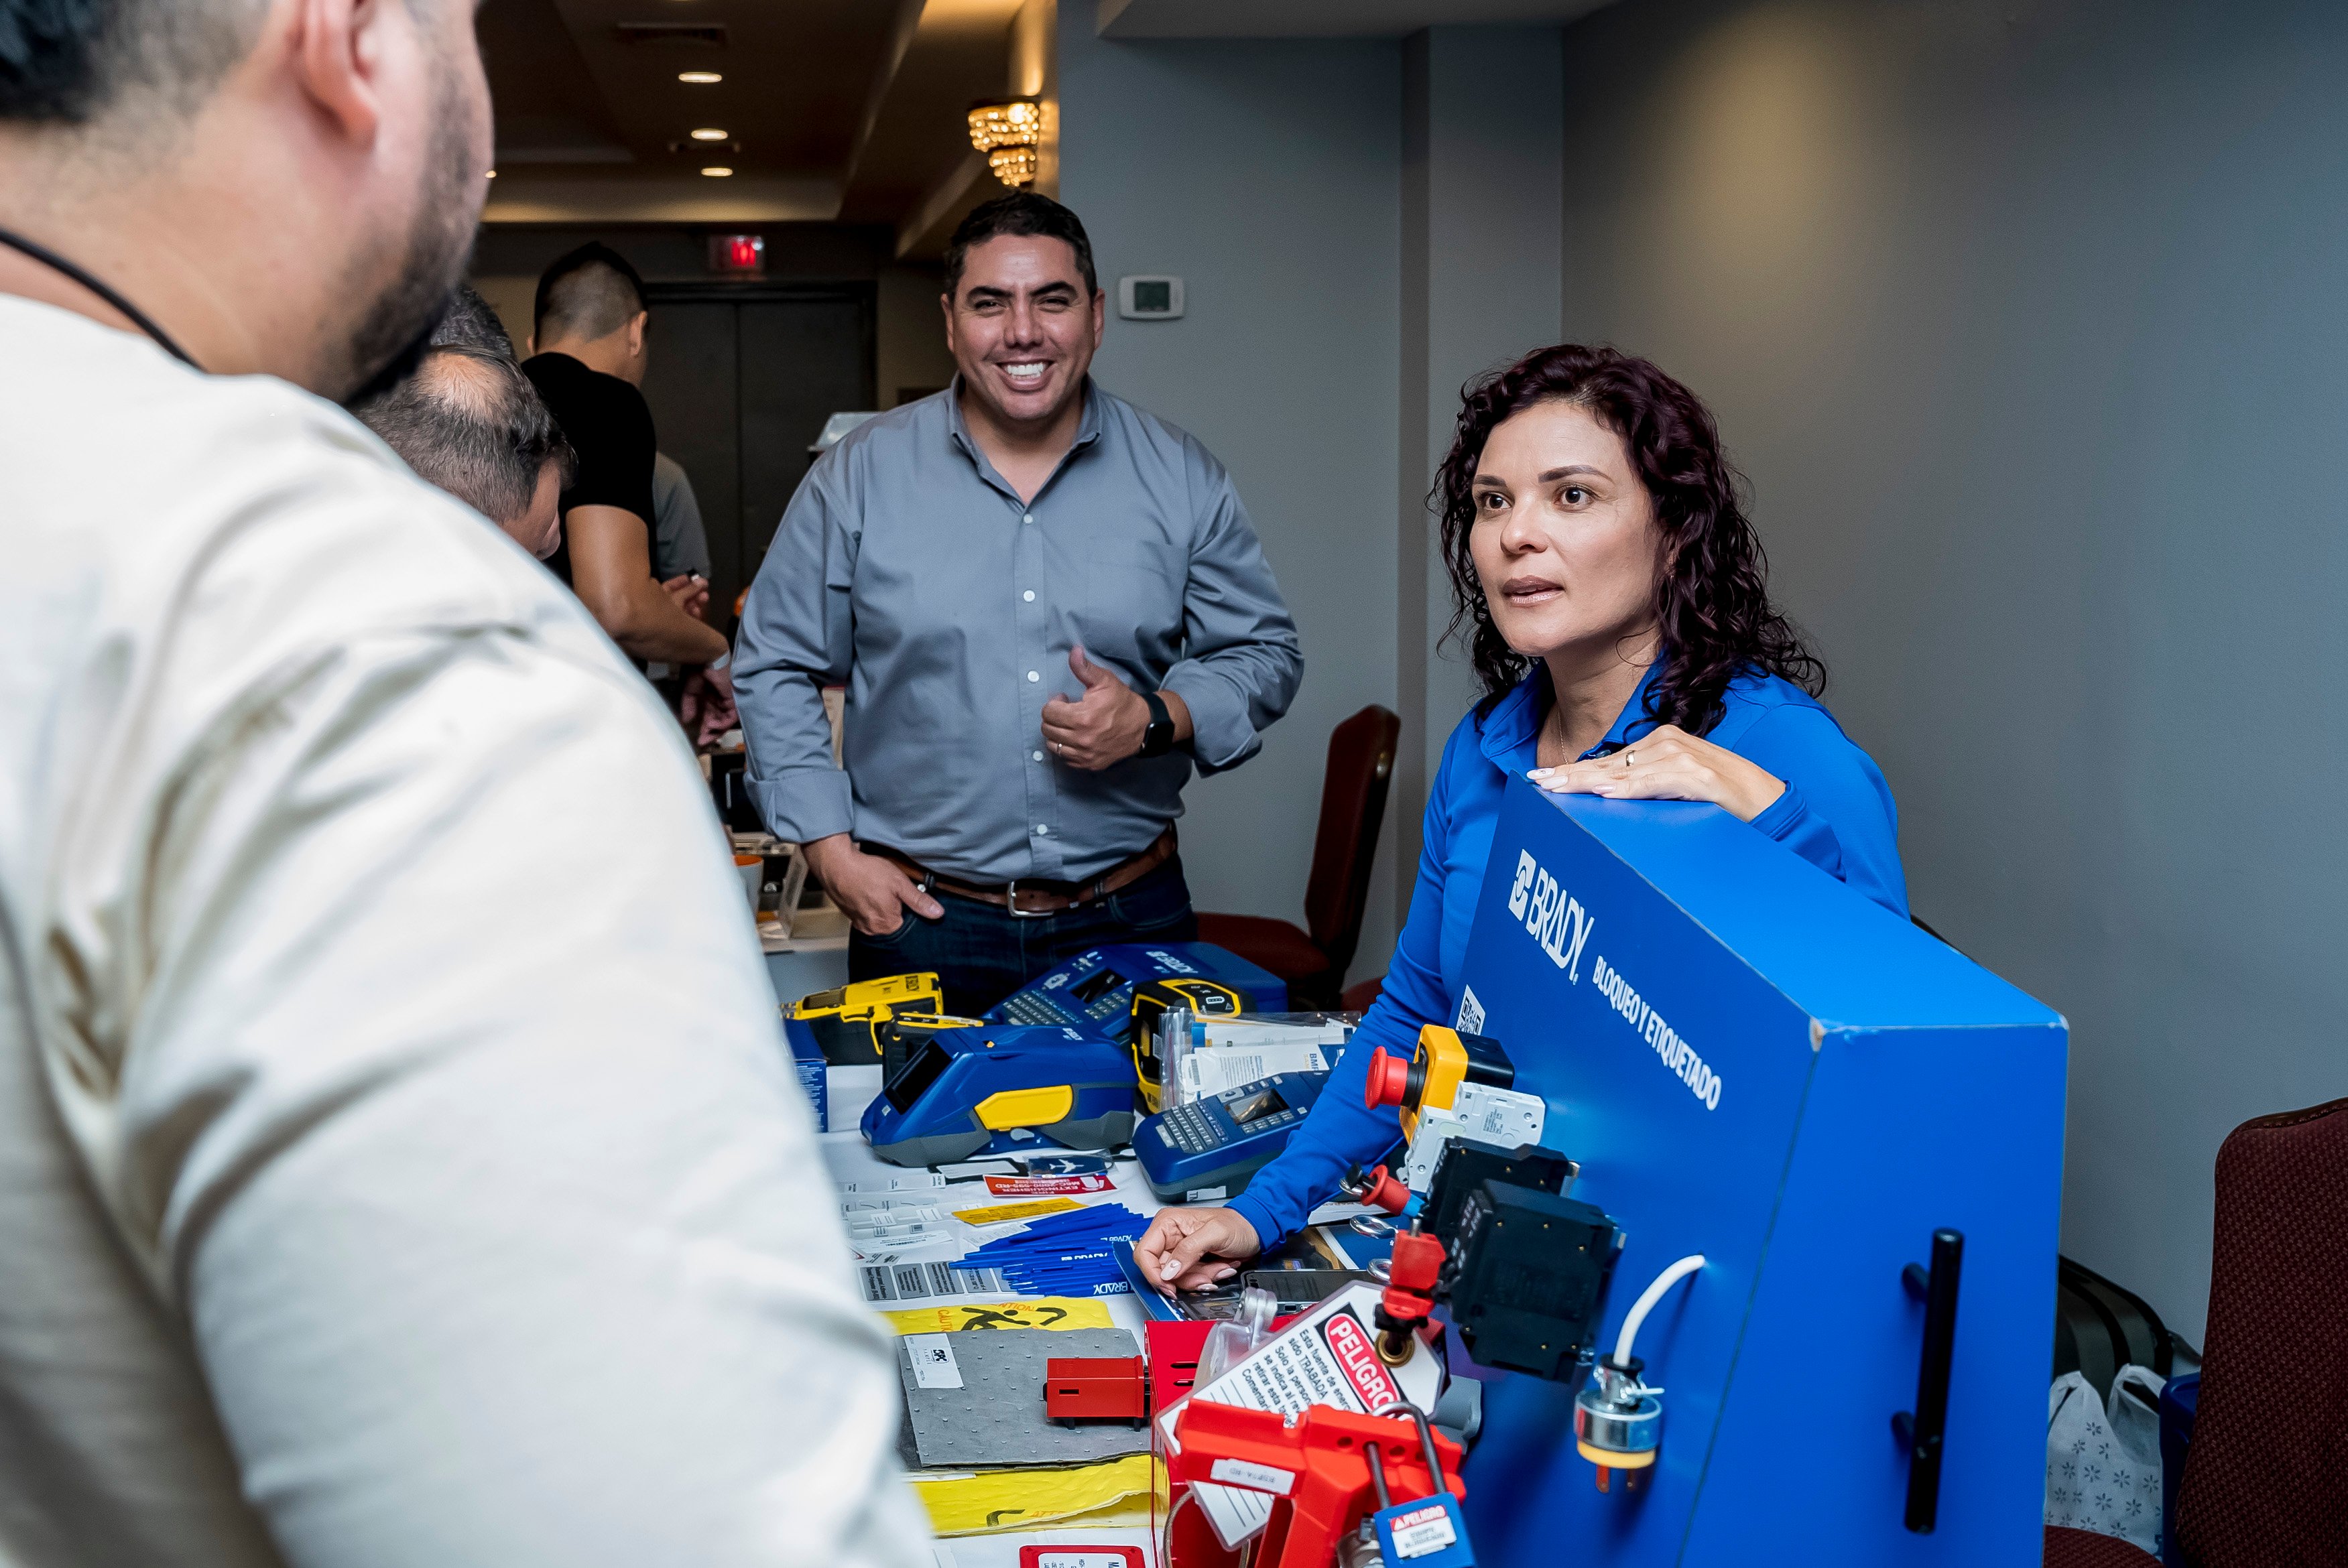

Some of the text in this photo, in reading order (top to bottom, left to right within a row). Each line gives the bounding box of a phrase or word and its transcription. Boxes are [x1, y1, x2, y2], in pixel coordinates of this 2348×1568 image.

[1592, 956, 1723, 1111] BLOQUEO Y ETIQUETADO
[1263, 1354, 1273, 1365] se
[1270, 1363, 1288, 1391] indica
[1284, 1389, 1294, 1400] al
[1275, 1345, 1289, 1366] Solo
[1286, 1365, 1294, 1376] la
[1288, 1337, 1329, 1400] sido TRABADA
[1299, 1329, 1314, 1349] Esta
[1310, 1348, 1329, 1376] fuente
[1326, 1375, 1337, 1387] de
[1252, 1362, 1270, 1387] retirar
[1267, 1386, 1281, 1407] esta
